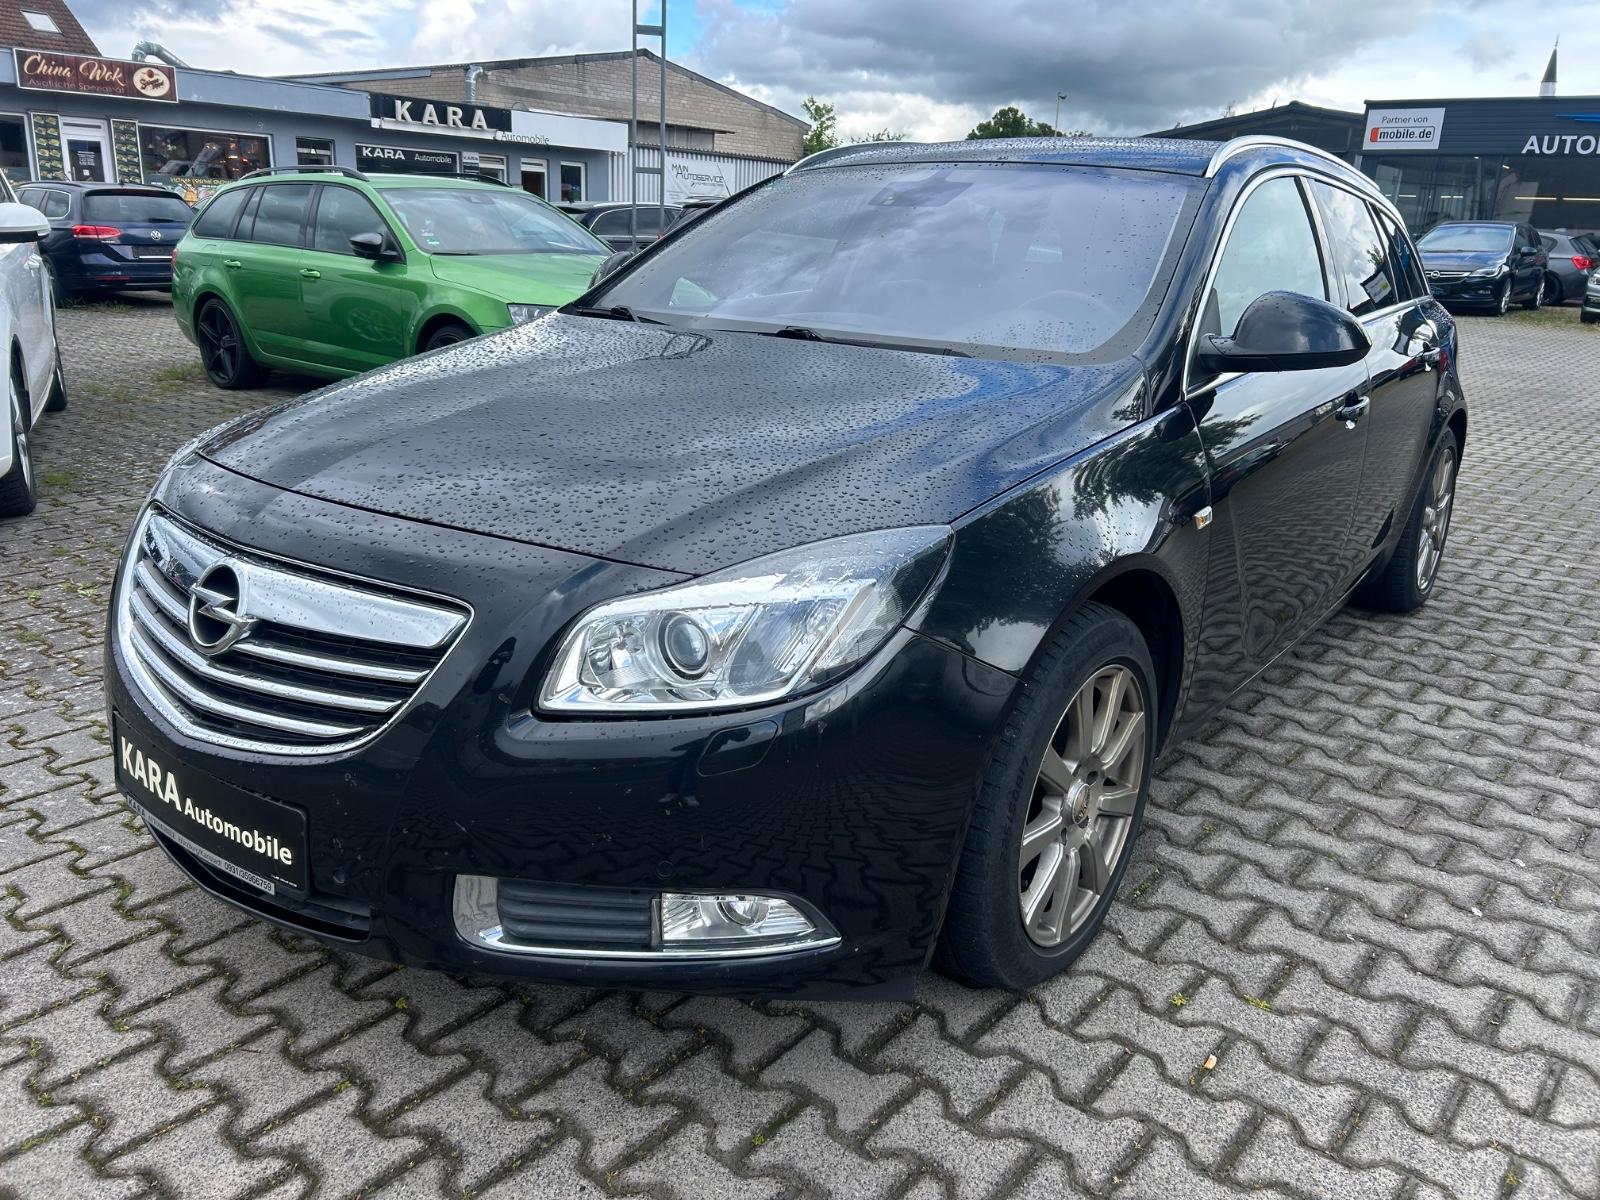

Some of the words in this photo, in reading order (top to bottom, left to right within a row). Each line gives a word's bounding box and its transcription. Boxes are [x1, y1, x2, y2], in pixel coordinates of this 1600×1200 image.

[23, 53, 72, 78] China
[79, 61, 126, 87] Wok
[395, 100, 488, 130] KARA
[1382, 116, 1411, 124] Partner
[501, 131, 550, 145] Automobile
[1379, 129, 1432, 139] mobile.de
[1521, 135, 1600, 155] AUTO
[362, 146, 406, 160] KARA
[415, 153, 452, 164] Automobile
[121, 736, 182, 812] KARA
[184, 797, 293, 865] Automobile
